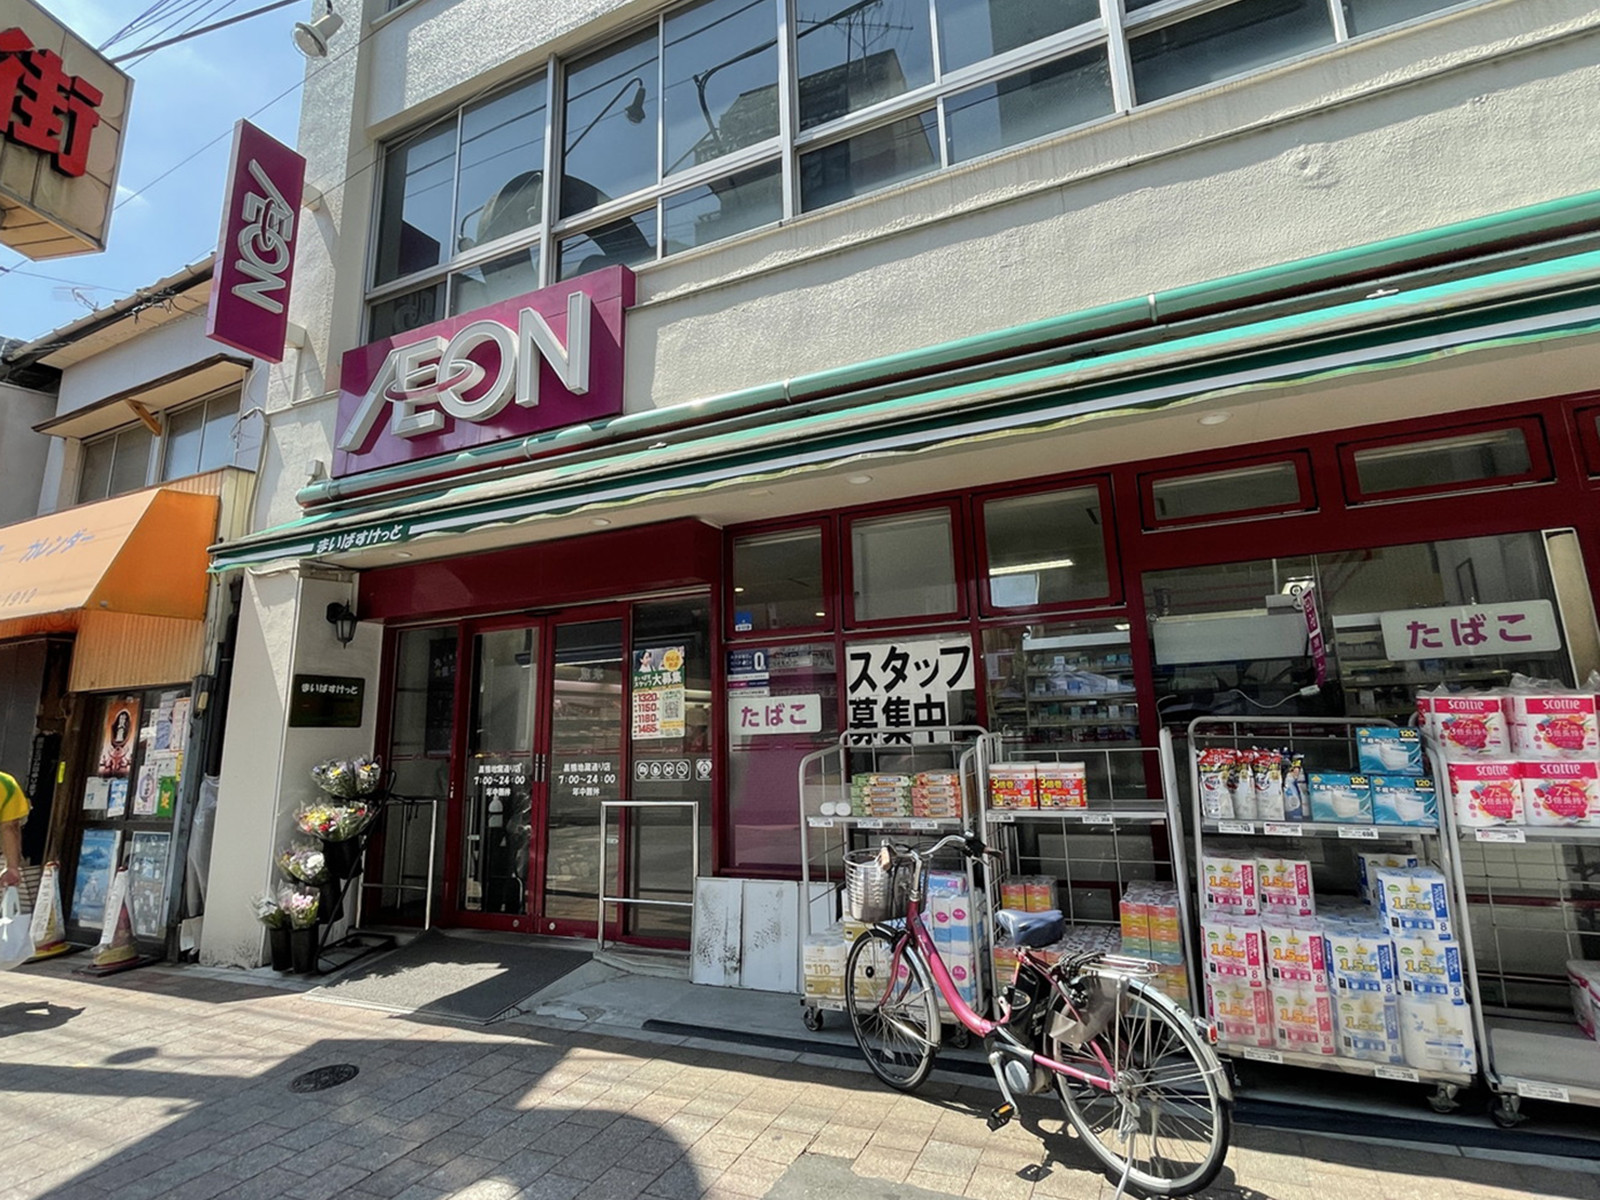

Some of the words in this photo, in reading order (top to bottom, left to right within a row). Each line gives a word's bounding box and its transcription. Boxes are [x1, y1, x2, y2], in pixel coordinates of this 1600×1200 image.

[0, 27, 103, 177] 街
[315, 524, 404, 554] まいばすけっと
[1407, 613, 1532, 649] たばこ
[849, 645, 970, 694] スタッフ
[301, 683, 359, 695] まいばすけっと
[741, 703, 807, 727] たばこ
[849, 693, 946, 745] 募集中
